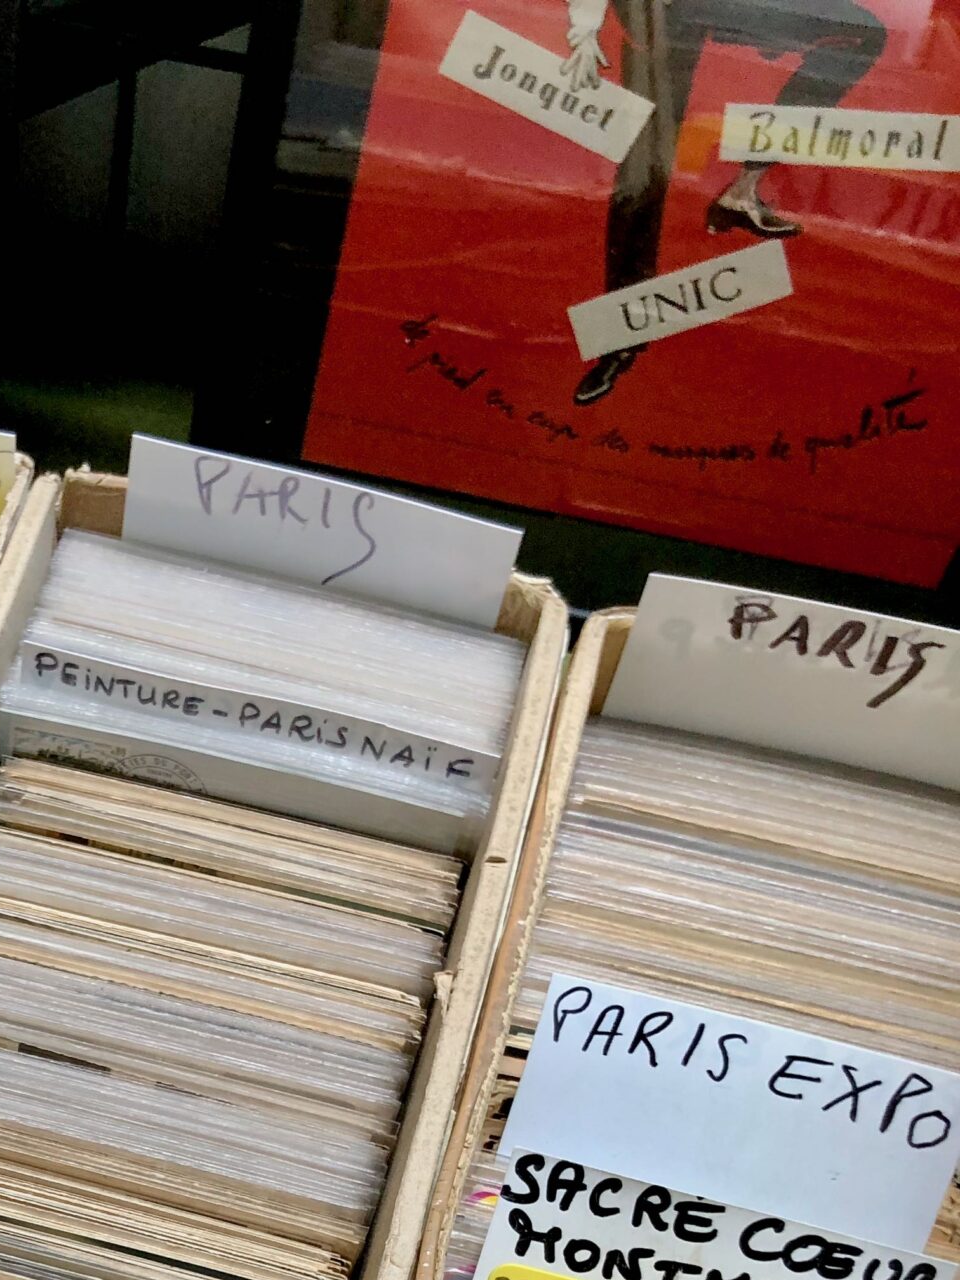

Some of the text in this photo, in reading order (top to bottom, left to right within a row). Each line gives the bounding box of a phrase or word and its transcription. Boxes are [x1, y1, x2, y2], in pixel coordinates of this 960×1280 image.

[473, 44, 615, 131] Jonquet
[749, 111, 948, 161] Balmoral
[620, 266, 742, 331] UNIC
[194, 455, 377, 586] PARIS
[728, 602, 946, 709] PARIS
[552, 986, 952, 1149] PARIS EXPO
